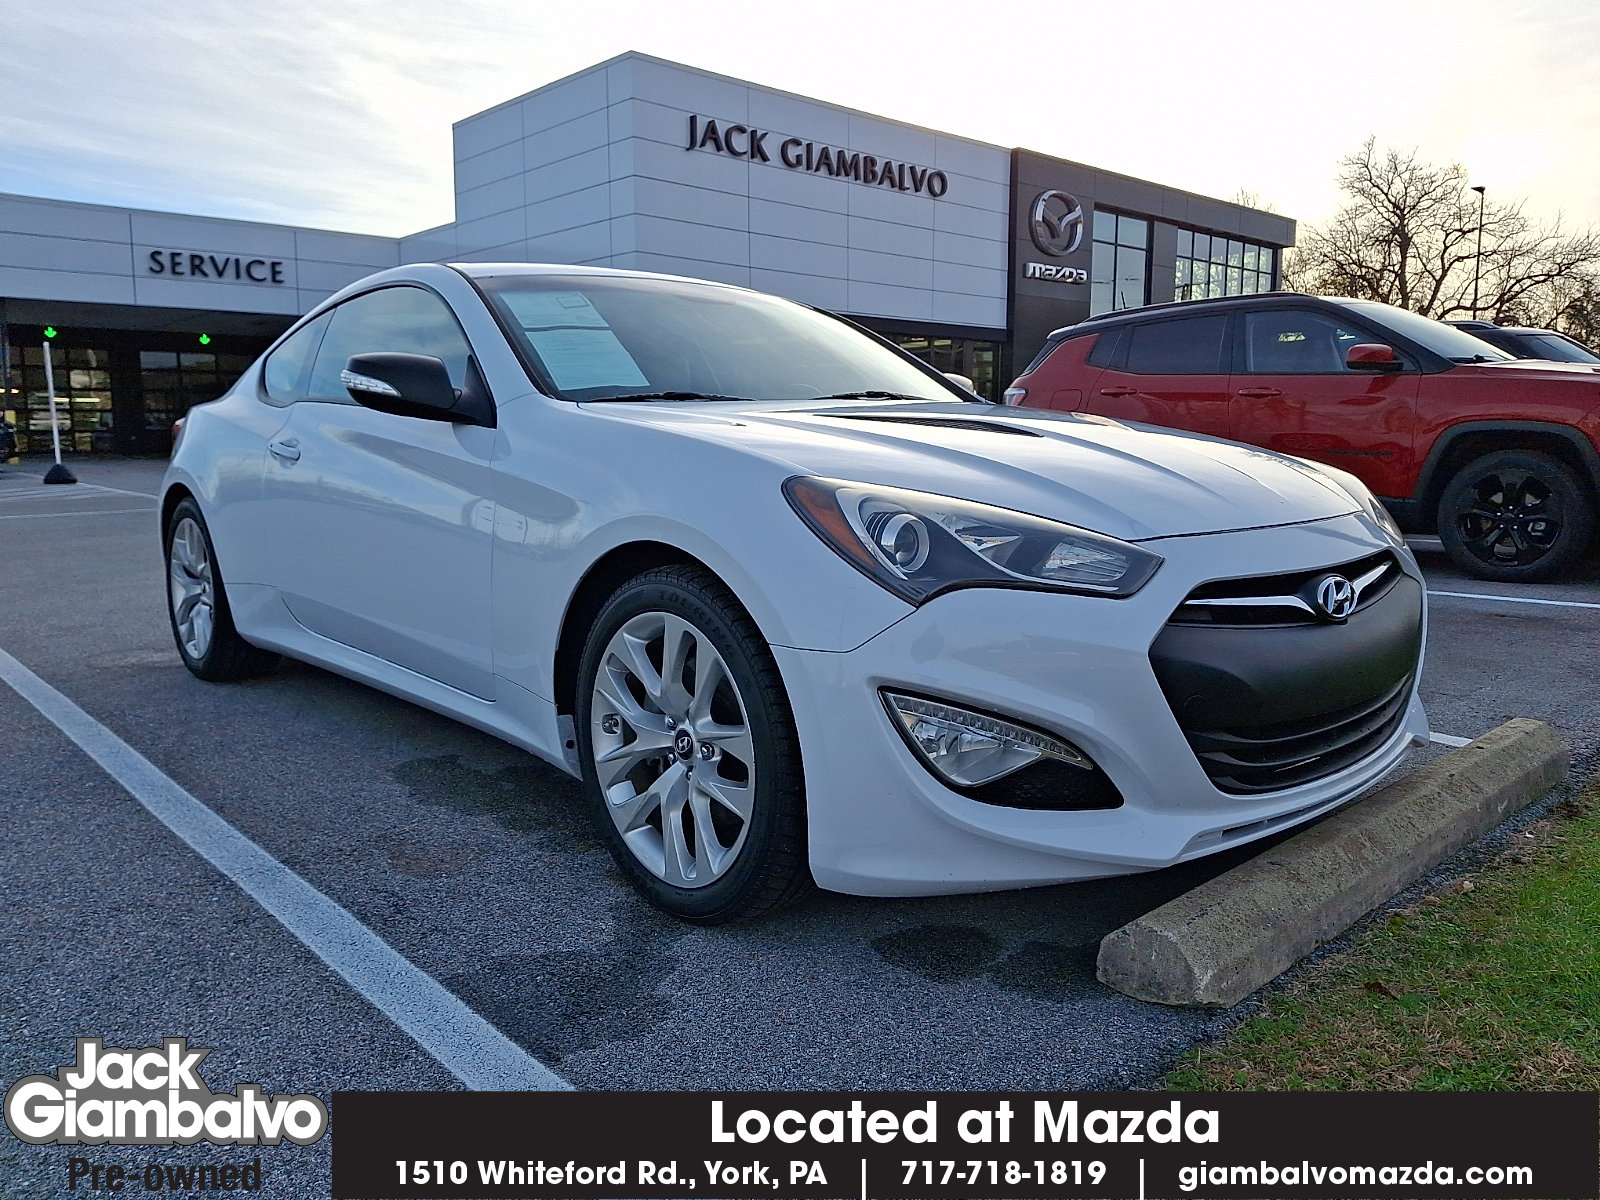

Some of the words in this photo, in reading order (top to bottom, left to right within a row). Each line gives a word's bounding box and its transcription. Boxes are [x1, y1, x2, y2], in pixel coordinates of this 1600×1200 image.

[686, 114, 771, 162] JACK
[780, 138, 949, 198] GIAMBALVO
[149, 250, 285, 284] SERVICE
